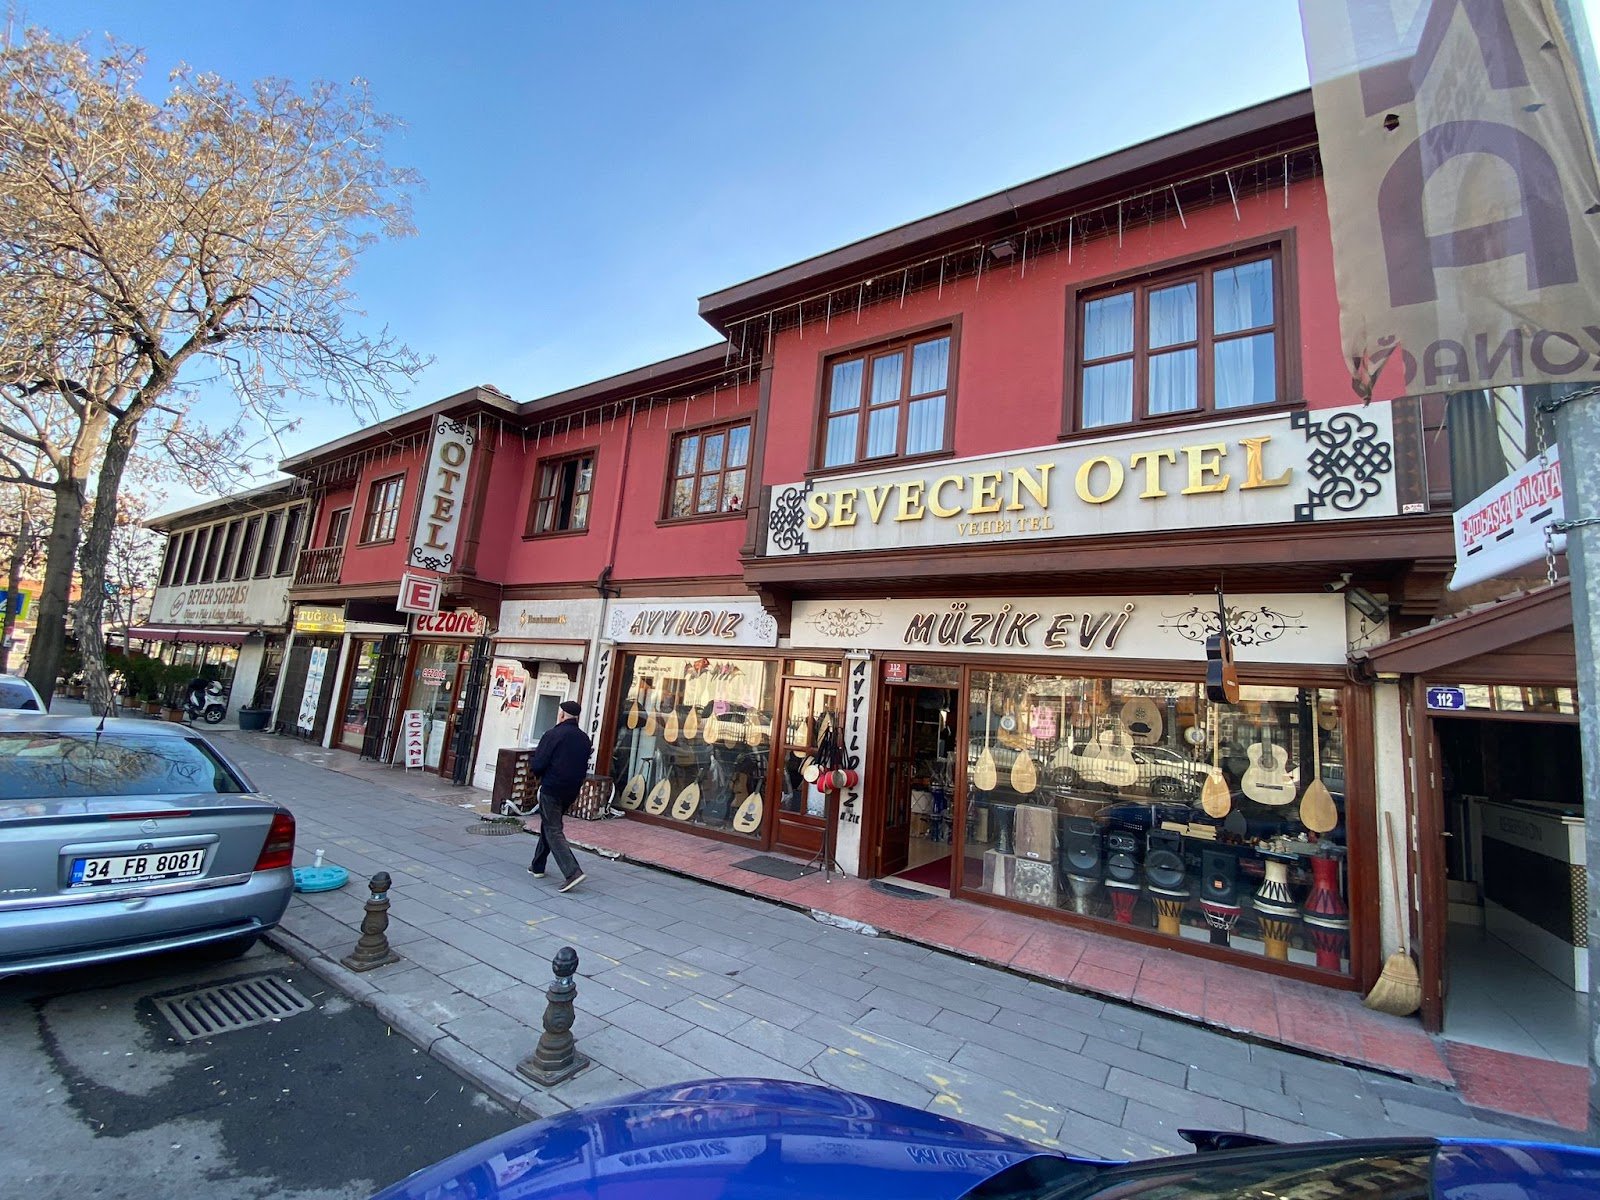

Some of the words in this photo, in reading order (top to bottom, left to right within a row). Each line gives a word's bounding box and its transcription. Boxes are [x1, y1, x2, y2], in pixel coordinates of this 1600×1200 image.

[424, 441, 466, 550] OTEL
[806, 463, 1056, 531] SEVECEN
[1074, 435, 1294, 505] OTEL
[1017, 515, 1055, 532] TEL
[187, 588, 213, 605] BEYLER
[215, 585, 249, 604] SOFRASI
[410, 584, 432, 608] E
[416, 611, 476, 632] eczane
[630, 610, 743, 638] AYYILDIZ
[903, 602, 1039, 647] MÜZİK
[1043, 602, 1135, 650] EVİ
[1437, 693, 1453, 706] 112
[409, 712, 421, 766] ECZANE
[844, 660, 866, 808] AYYILDZ
[86, 861, 110, 878] 34
[124, 858, 147, 876] FB
[157, 852, 199, 872] 8081
